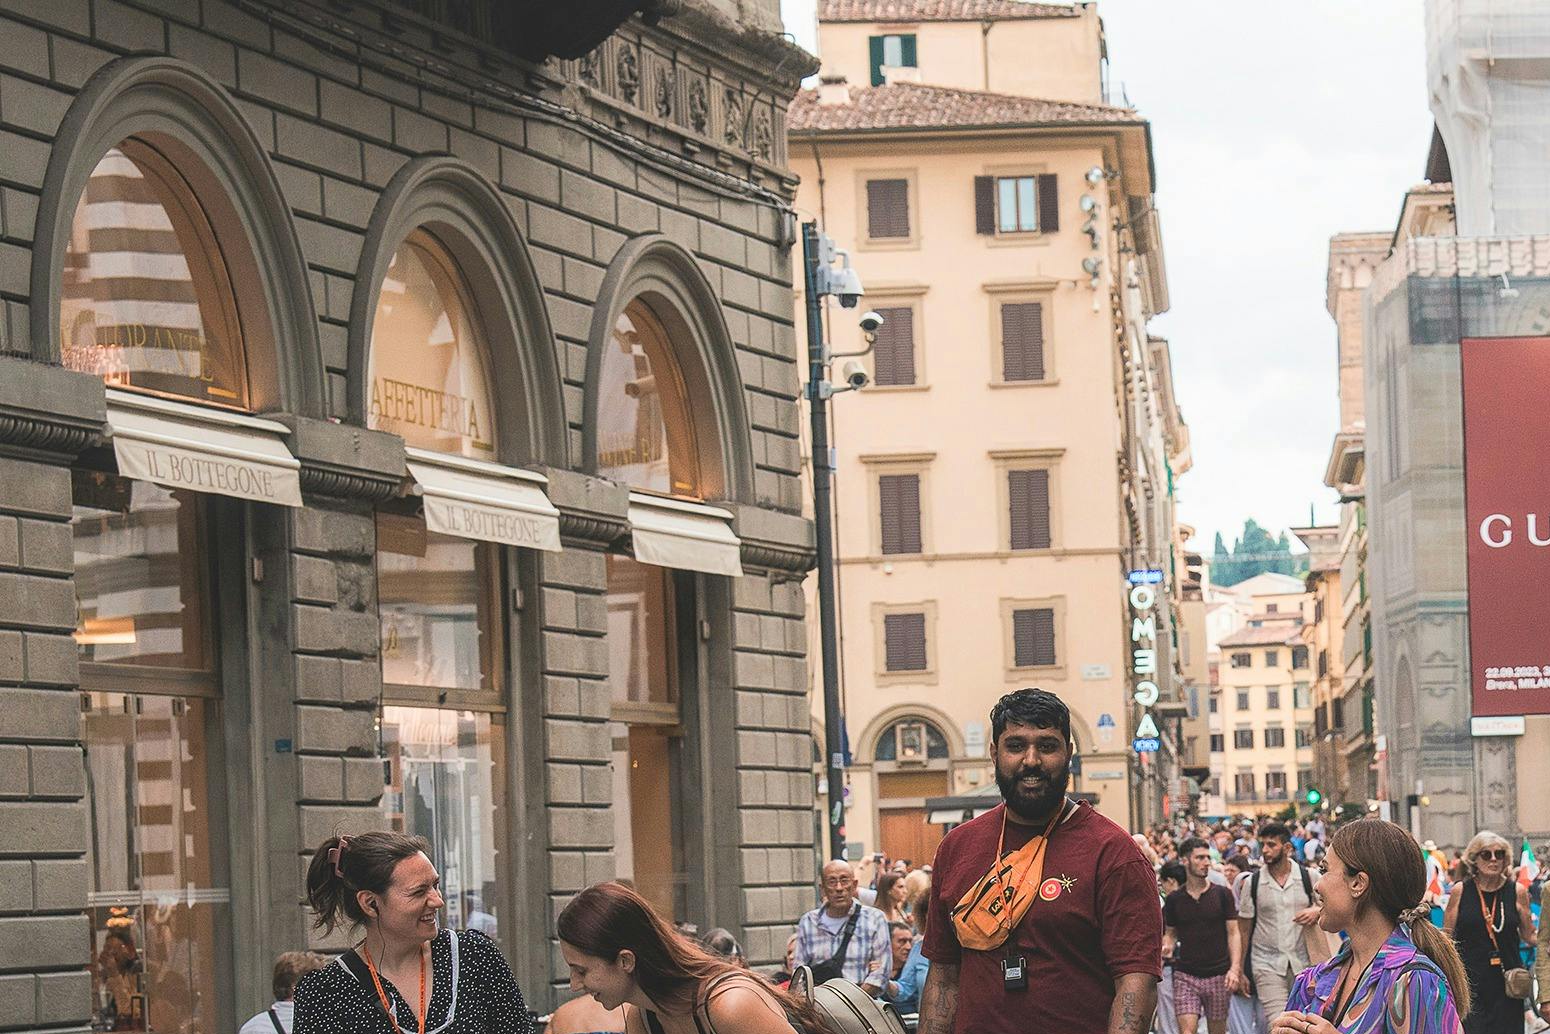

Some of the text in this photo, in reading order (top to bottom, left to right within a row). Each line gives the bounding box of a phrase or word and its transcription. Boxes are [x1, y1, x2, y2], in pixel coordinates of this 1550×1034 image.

[145, 449, 274, 498] IL BOTTEGONE
[446, 505, 540, 543] IL BOTTEGONE
